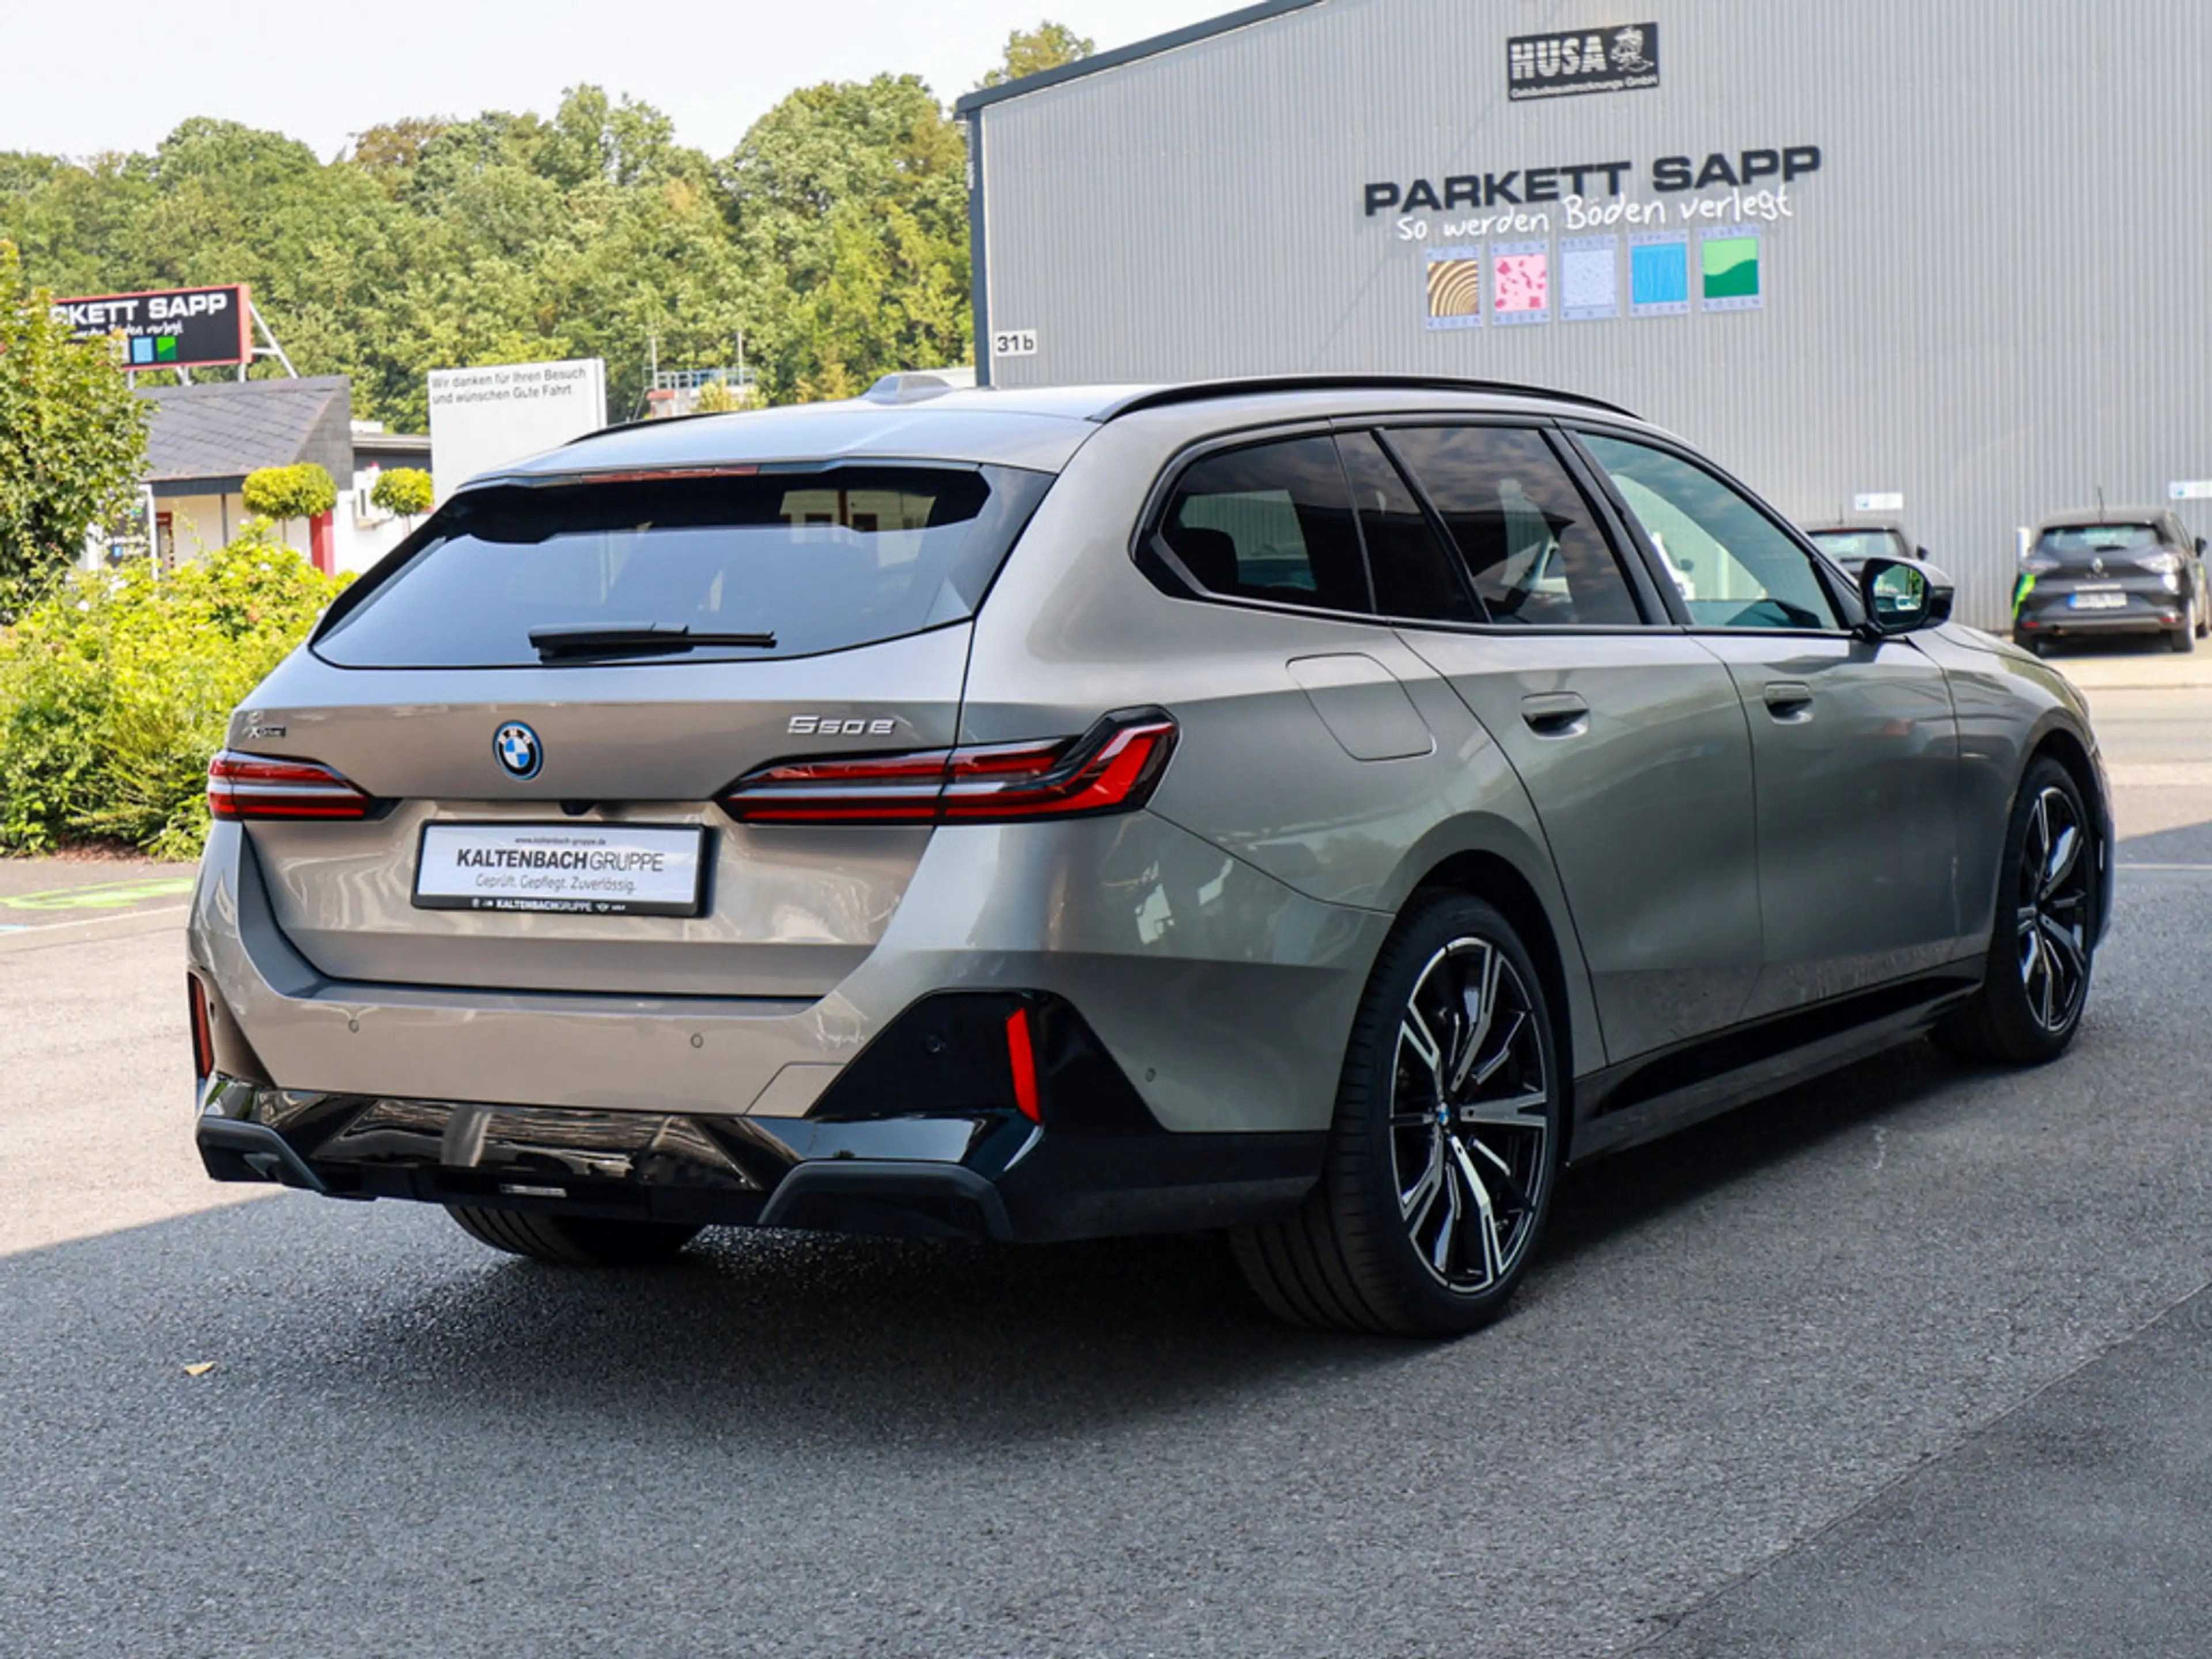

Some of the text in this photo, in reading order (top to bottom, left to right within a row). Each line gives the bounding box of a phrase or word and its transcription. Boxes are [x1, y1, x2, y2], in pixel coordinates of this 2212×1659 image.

[1510, 37, 1607, 79] HUSA
[1365, 146, 1821, 217] PARKETT SAPP
[1444, 205, 1550, 237] werden
[1562, 191, 1666, 230] Böden
[1680, 185, 1793, 221] verlegt
[149, 293, 228, 319] SAPP
[452, 375, 493, 387] danken
[544, 366, 586, 381] Besuch
[513, 386, 540, 399] Gute
[541, 384, 572, 396] Fahrt
[457, 849, 665, 872] KALTENBACHGRUPPE
